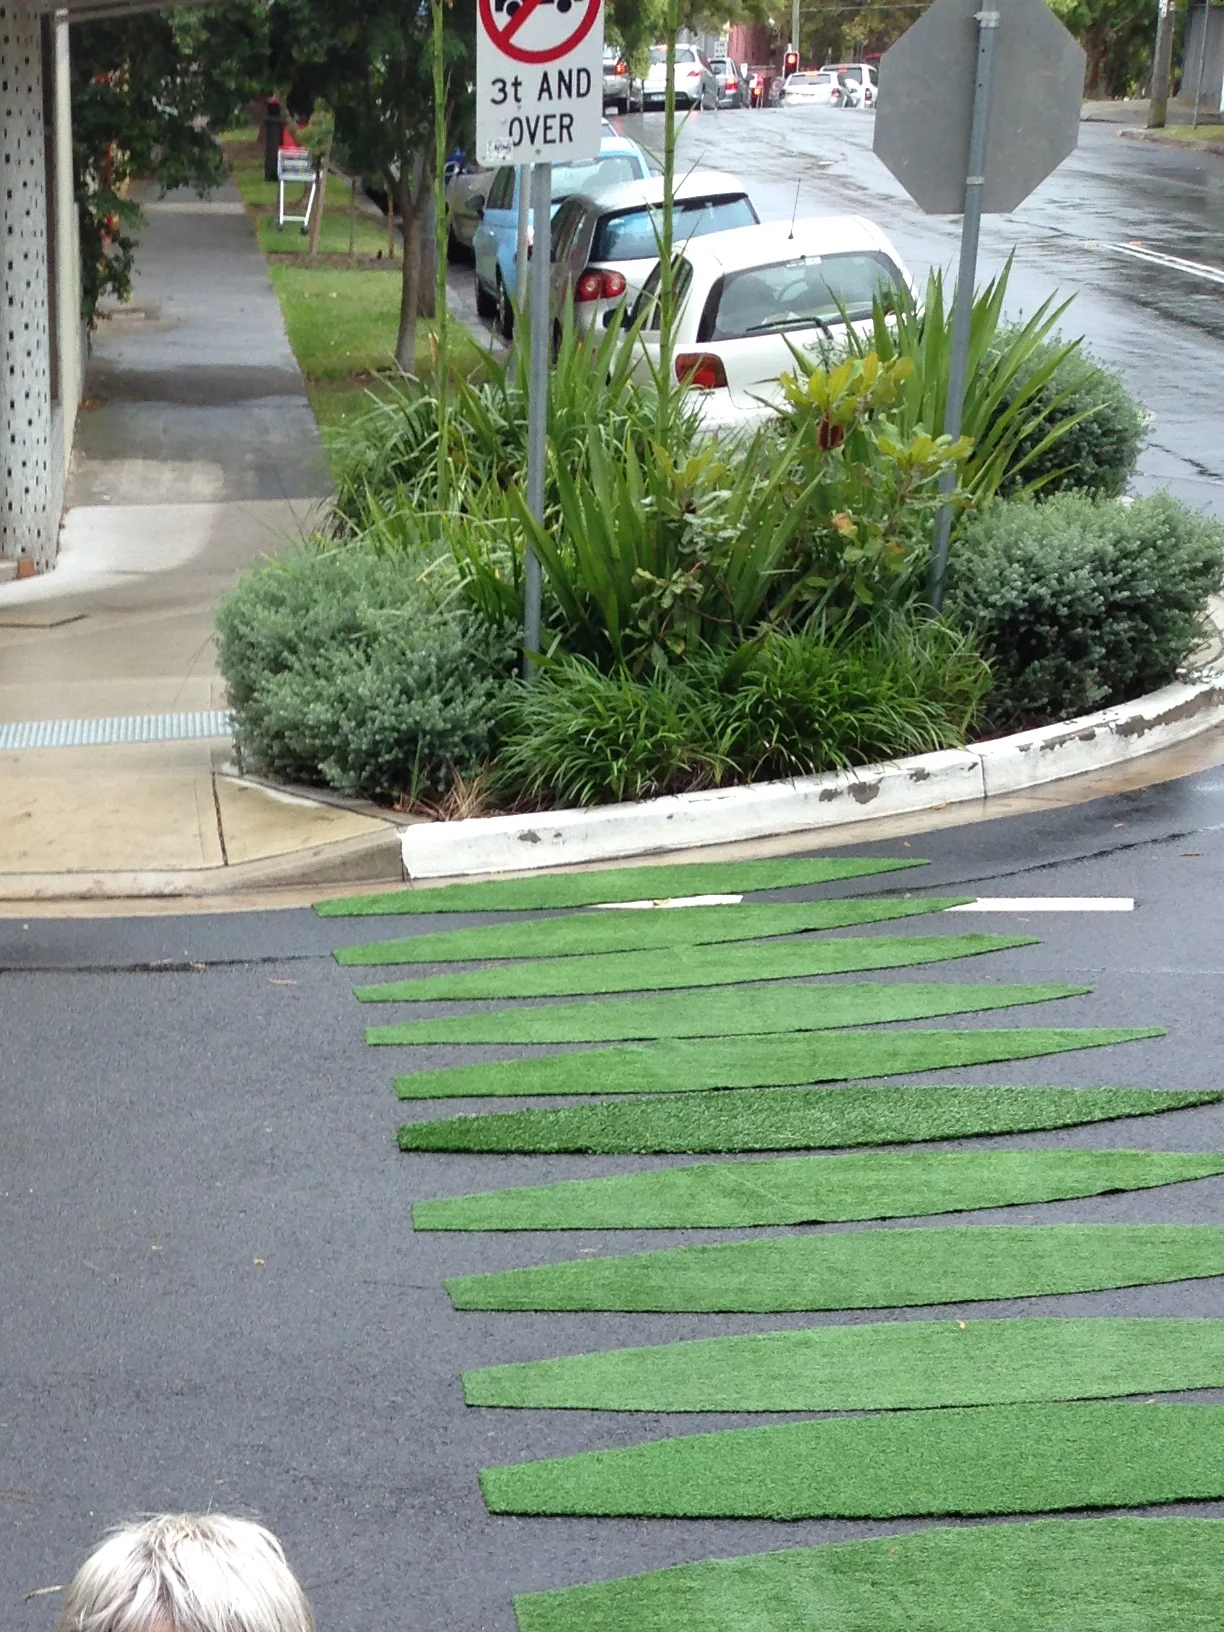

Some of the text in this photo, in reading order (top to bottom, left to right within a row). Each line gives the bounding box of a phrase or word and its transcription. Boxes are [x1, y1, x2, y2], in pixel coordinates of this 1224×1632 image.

[490, 67, 591, 105] 3t AND
[509, 112, 574, 147] OVER
